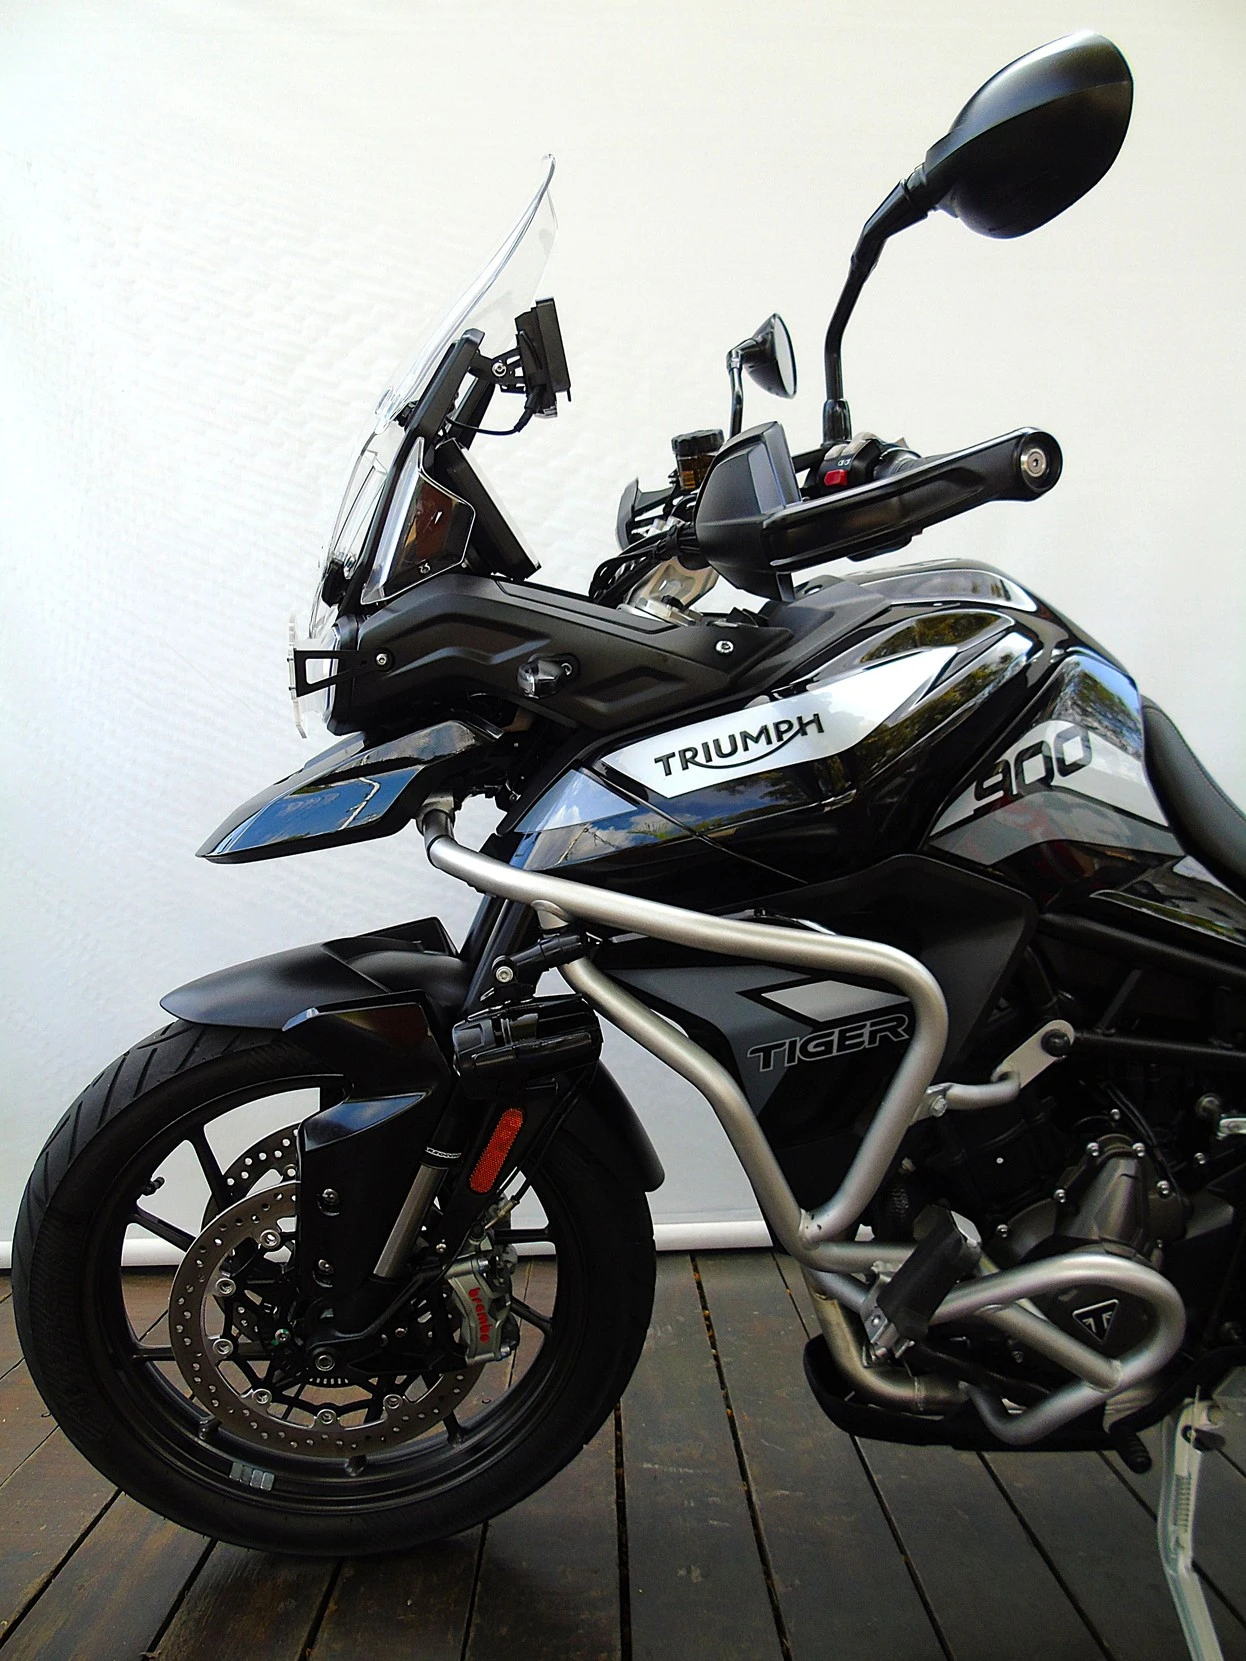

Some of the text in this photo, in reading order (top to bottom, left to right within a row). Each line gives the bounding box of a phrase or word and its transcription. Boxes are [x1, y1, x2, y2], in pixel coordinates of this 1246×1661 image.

[654, 713, 825, 777] TRIUMPH
[974, 725, 1093, 812] 900
[747, 1014, 910, 1072] TIGER
[468, 1287, 493, 1344] brembo
